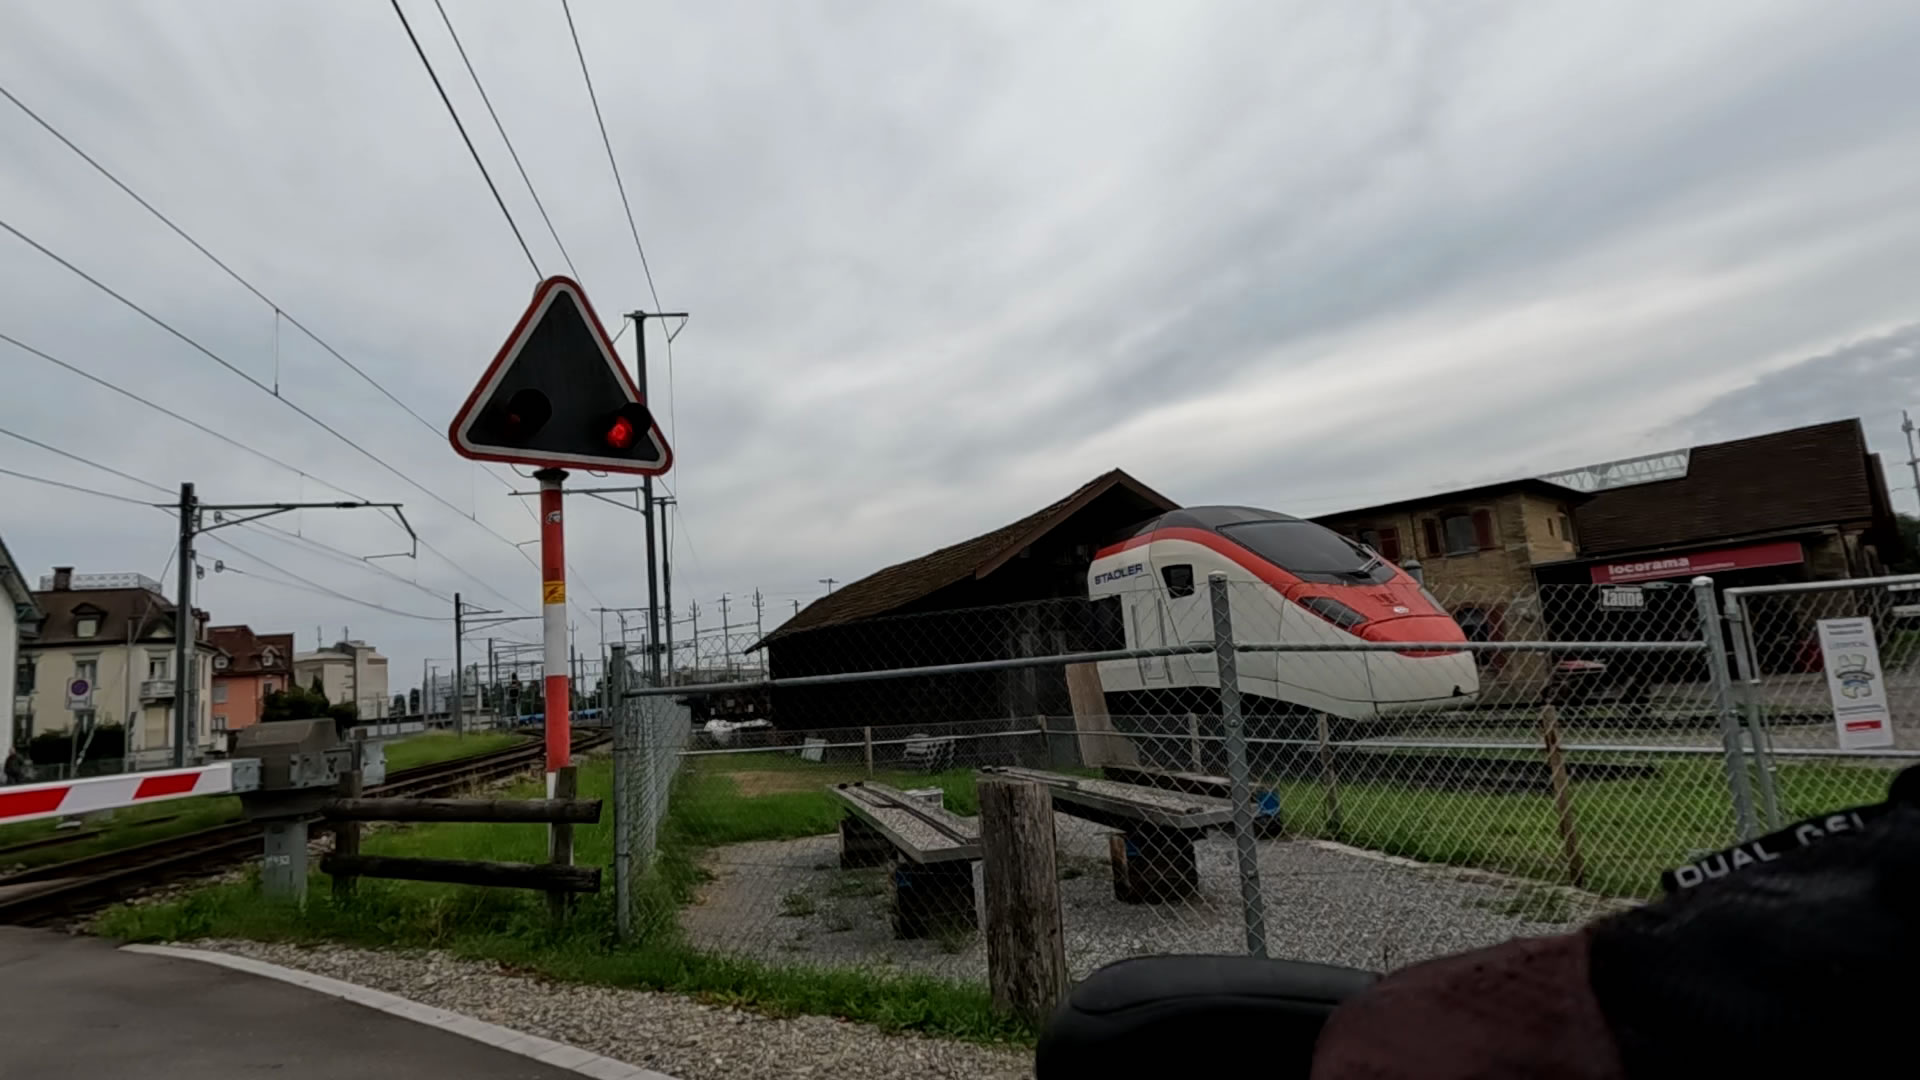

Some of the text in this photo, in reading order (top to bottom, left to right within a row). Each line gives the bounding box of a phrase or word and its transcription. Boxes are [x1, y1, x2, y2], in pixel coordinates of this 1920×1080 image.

[1095, 563, 1143, 585] STADLER
[1607, 557, 1690, 575] locorama
[1674, 841, 1782, 889] DUAL
